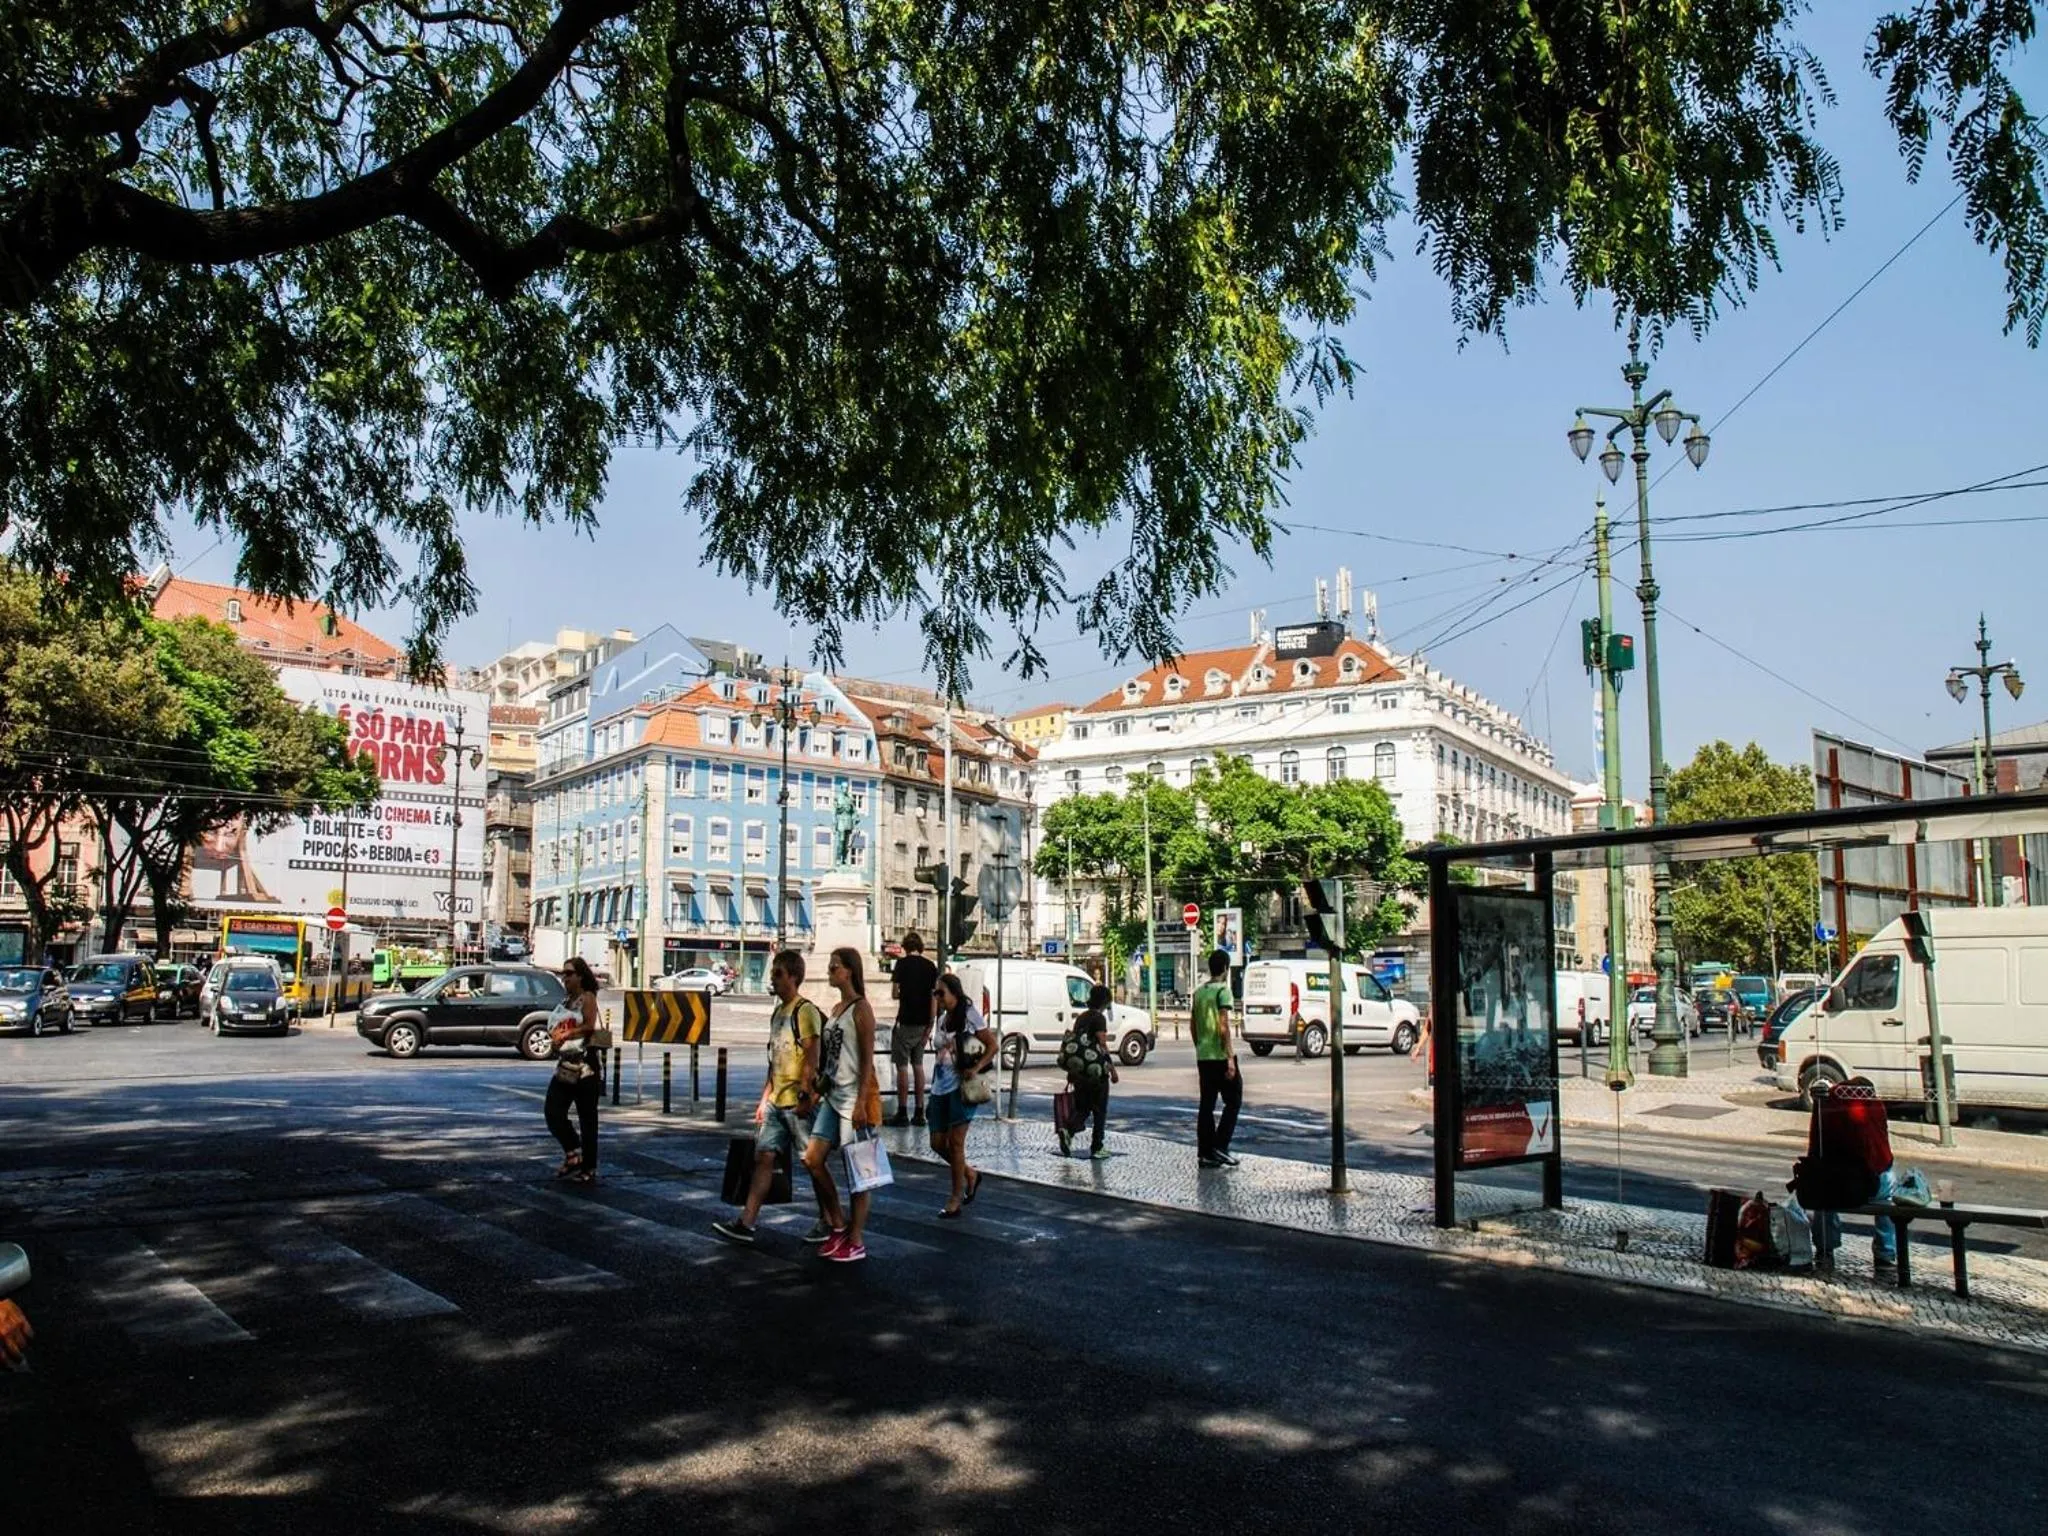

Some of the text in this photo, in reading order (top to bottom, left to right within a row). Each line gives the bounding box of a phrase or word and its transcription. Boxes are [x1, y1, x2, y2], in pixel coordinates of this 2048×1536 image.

[323, 688, 346, 699] ISTO
[352, 690, 370, 702] NÃO
[385, 697, 408, 707] PARA
[355, 707, 385, 740] SÓ
[390, 716, 446, 746] PARA
[385, 806, 431, 825] CINEMA
[434, 807, 441, 825] É
[314, 820, 365, 839] BILHETE
[376, 825, 393, 840] €3
[303, 840, 358, 859] PIPOCAS
[370, 845, 413, 863] BEBIDA
[424, 849, 439, 864] €3
